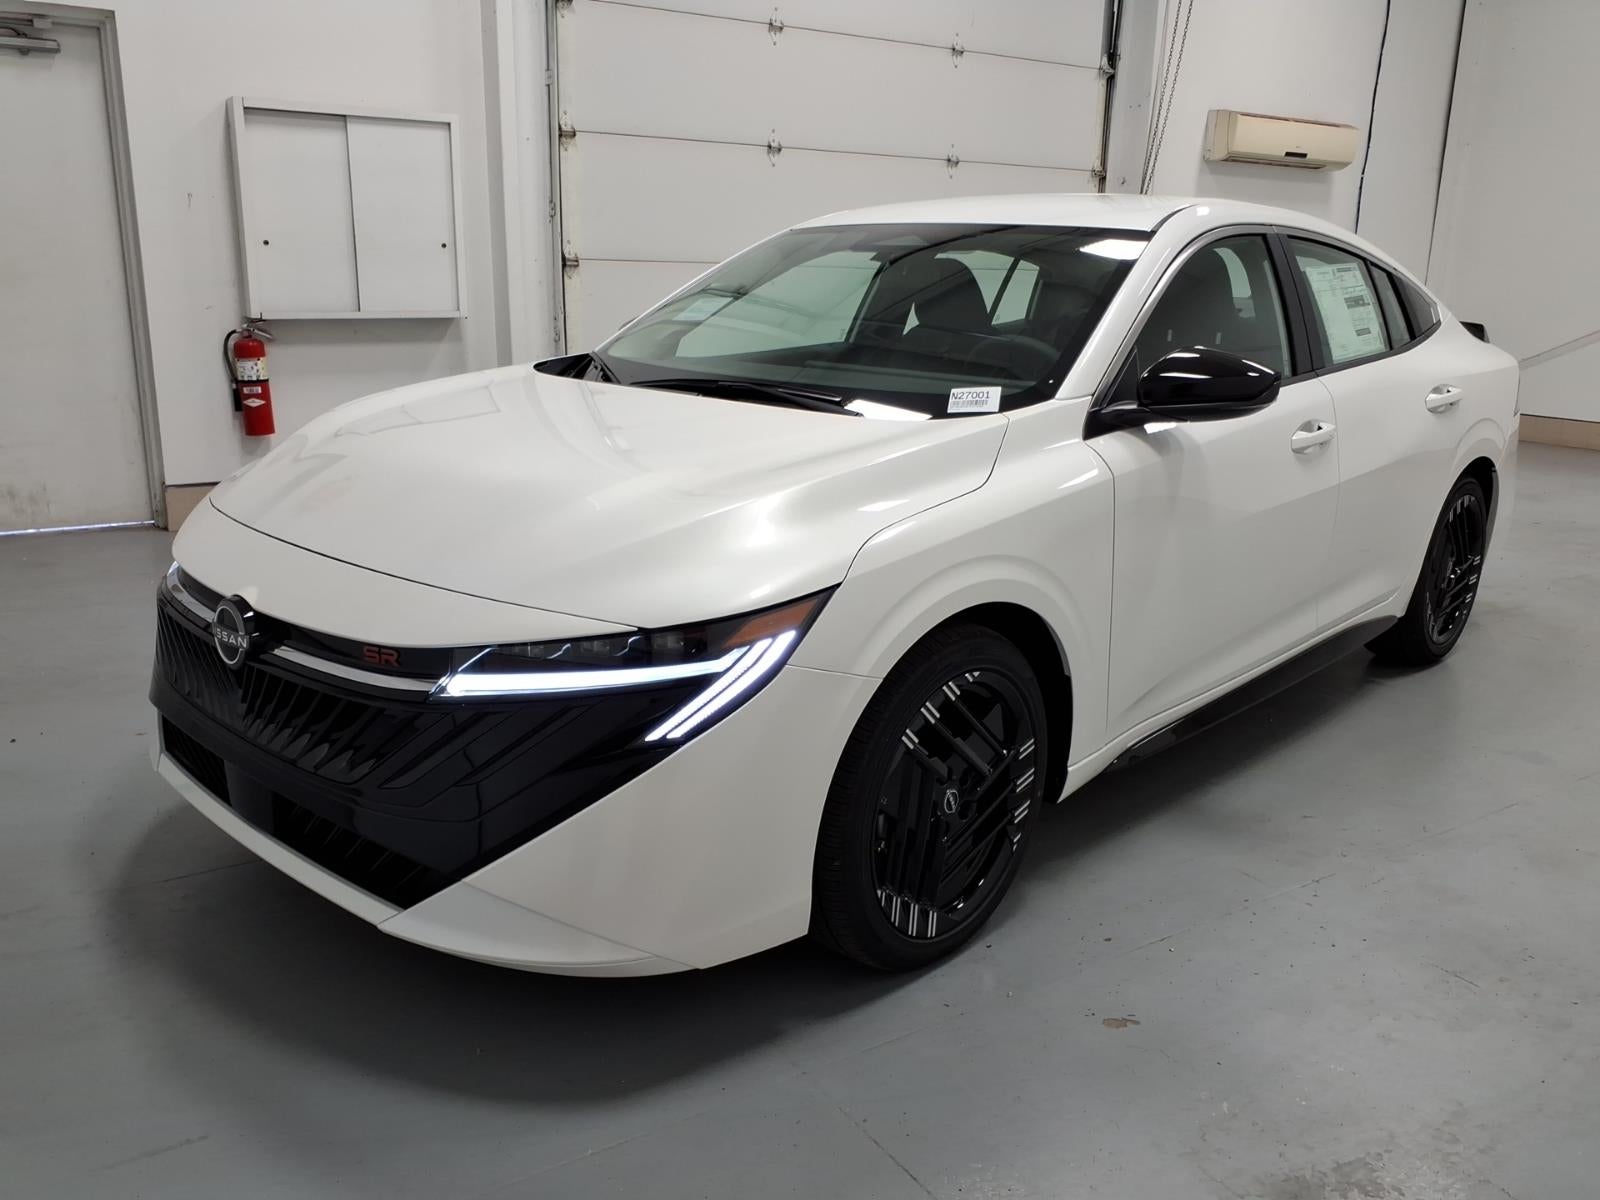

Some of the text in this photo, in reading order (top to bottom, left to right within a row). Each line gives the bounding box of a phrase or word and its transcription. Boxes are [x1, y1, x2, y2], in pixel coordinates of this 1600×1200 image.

[951, 391, 990, 400] N27001
[213, 624, 247, 649] SSAN
[363, 645, 400, 667] SR
